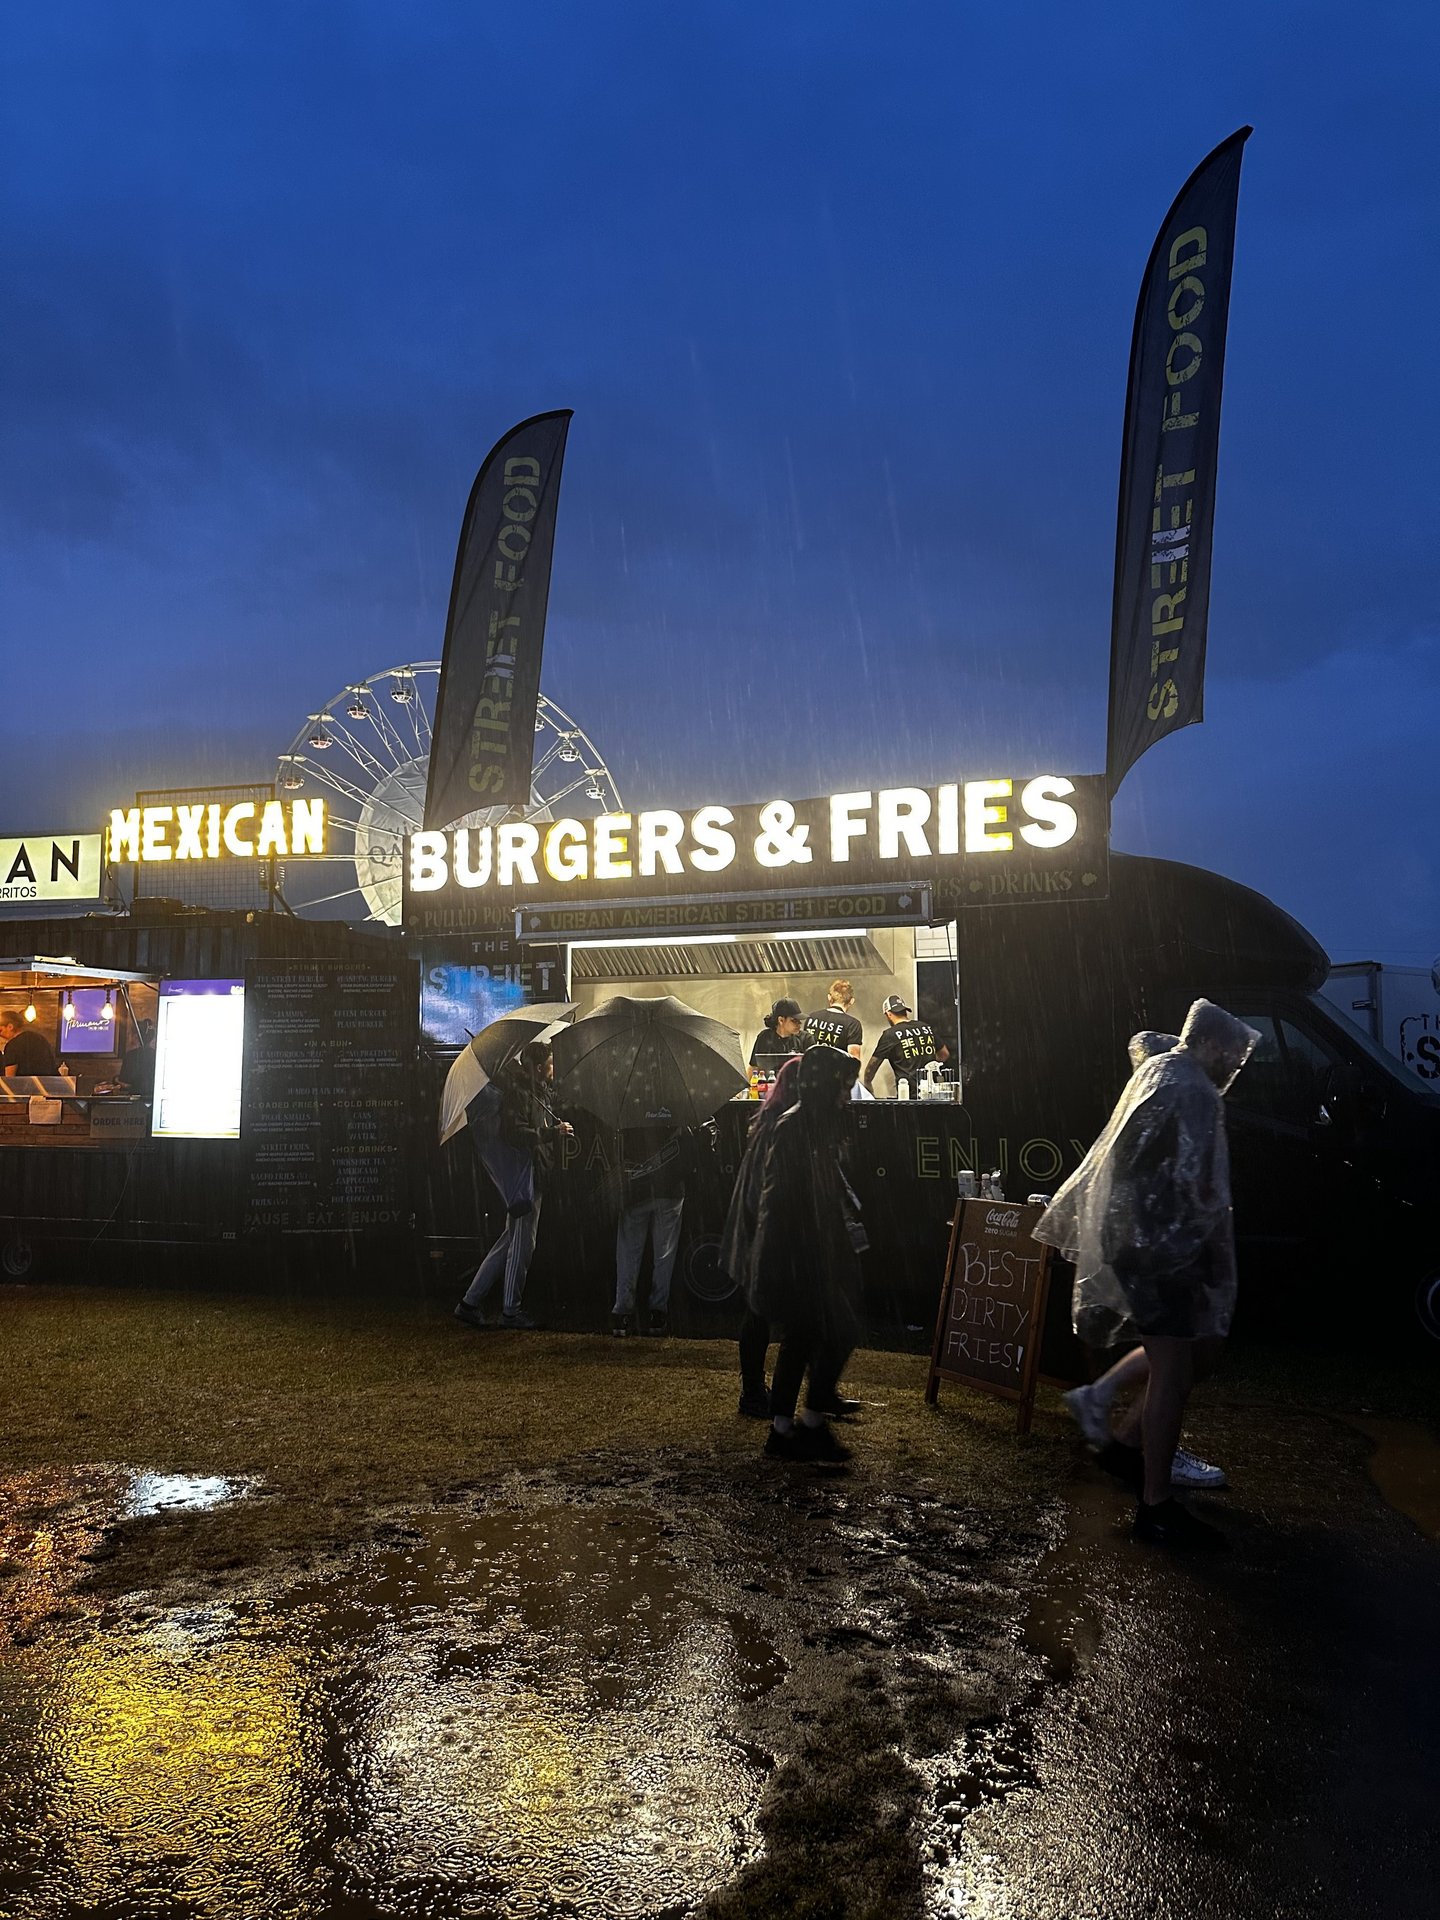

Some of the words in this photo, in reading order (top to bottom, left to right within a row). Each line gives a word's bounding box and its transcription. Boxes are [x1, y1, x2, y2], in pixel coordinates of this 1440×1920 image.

[1161, 223, 1208, 434] FOOD
[493, 456, 541, 592] FOOD
[109, 797, 326, 863] MEXICAN
[408, 804, 736, 893] BURGERS
[753, 799, 814, 867] &
[829, 775, 1079, 863] FRIES
[989, 870, 1073, 896] DRINKS
[0, 886, 37, 899] RITOS
[549, 910, 615, 931] URBAN
[620, 904, 728, 929] AMERICAN
[824, 896, 887, 917] FOOD
[471, 941, 509, 953] THE
[807, 1018, 844, 1034] PAUSE
[818, 1031, 839, 1043] EAT
[253, 1101, 289, 1109] LOADED
[337, 1100, 362, 1108] COLD
[365, 1099, 399, 1107] DRINKS
[92, 1117, 121, 1126] ORDER
[123, 1117, 145, 1126] HERE
[359, 1145, 393, 1153] DRINKS
[245, 1212, 289, 1225] PAUSE
[307, 1211, 334, 1224] EAT
[352, 1210, 401, 1223] ENJOY
[984, 1227, 999, 1235] zero
[960, 1242, 1041, 1293] BEST
[951, 1288, 1030, 1337] DIRTY
[947, 1331, 1024, 1373] FRIES!
